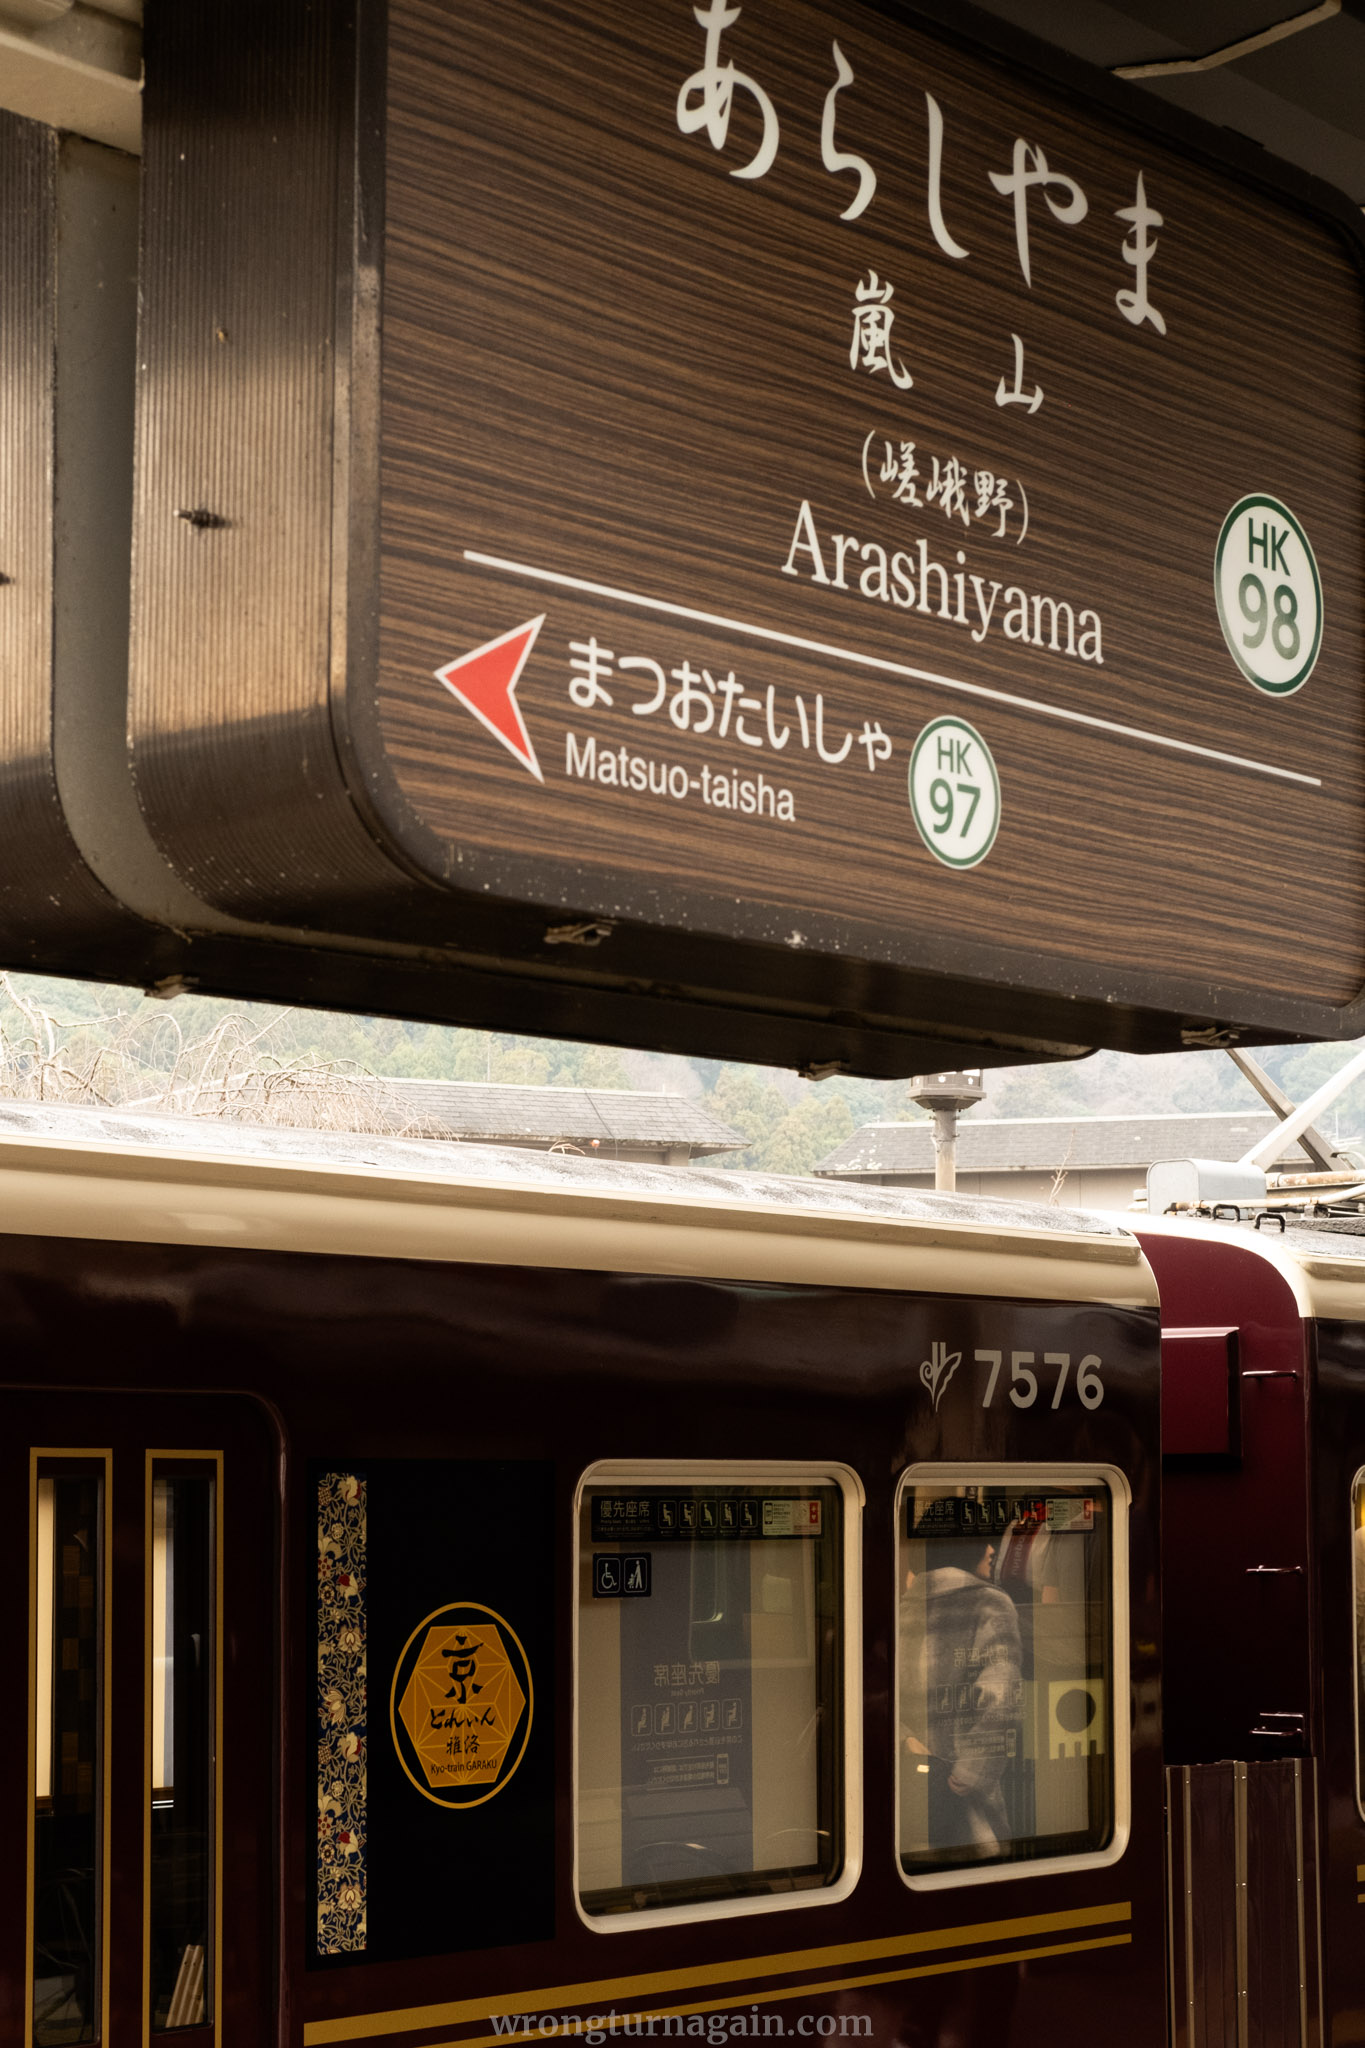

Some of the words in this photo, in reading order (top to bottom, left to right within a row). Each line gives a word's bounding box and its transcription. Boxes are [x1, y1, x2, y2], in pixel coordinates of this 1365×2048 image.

[676, 0, 1166, 335] あらしやま
[850, 269, 1044, 414] 嵐山
[1248, 516, 1291, 577] HK
[781, 500, 1105, 664] Arashiyama
[1238, 572, 1301, 661] 98
[568, 637, 893, 772] まつおたいしゃ
[566, 732, 796, 822] Matsuo-taisha
[937, 735, 975, 777] HK
[928, 777, 982, 839] 97
[974, 1349, 1105, 1411] 7576
[600, 1500, 650, 1519] 優先座席
[441, 1635, 484, 1704] 京
[430, 1707, 496, 1730] とれいん
[446, 1734, 481, 1756] 雅洛
[431, 1763, 465, 1776] Kyo-train
[466, 1759, 498, 1772] GARAKU
